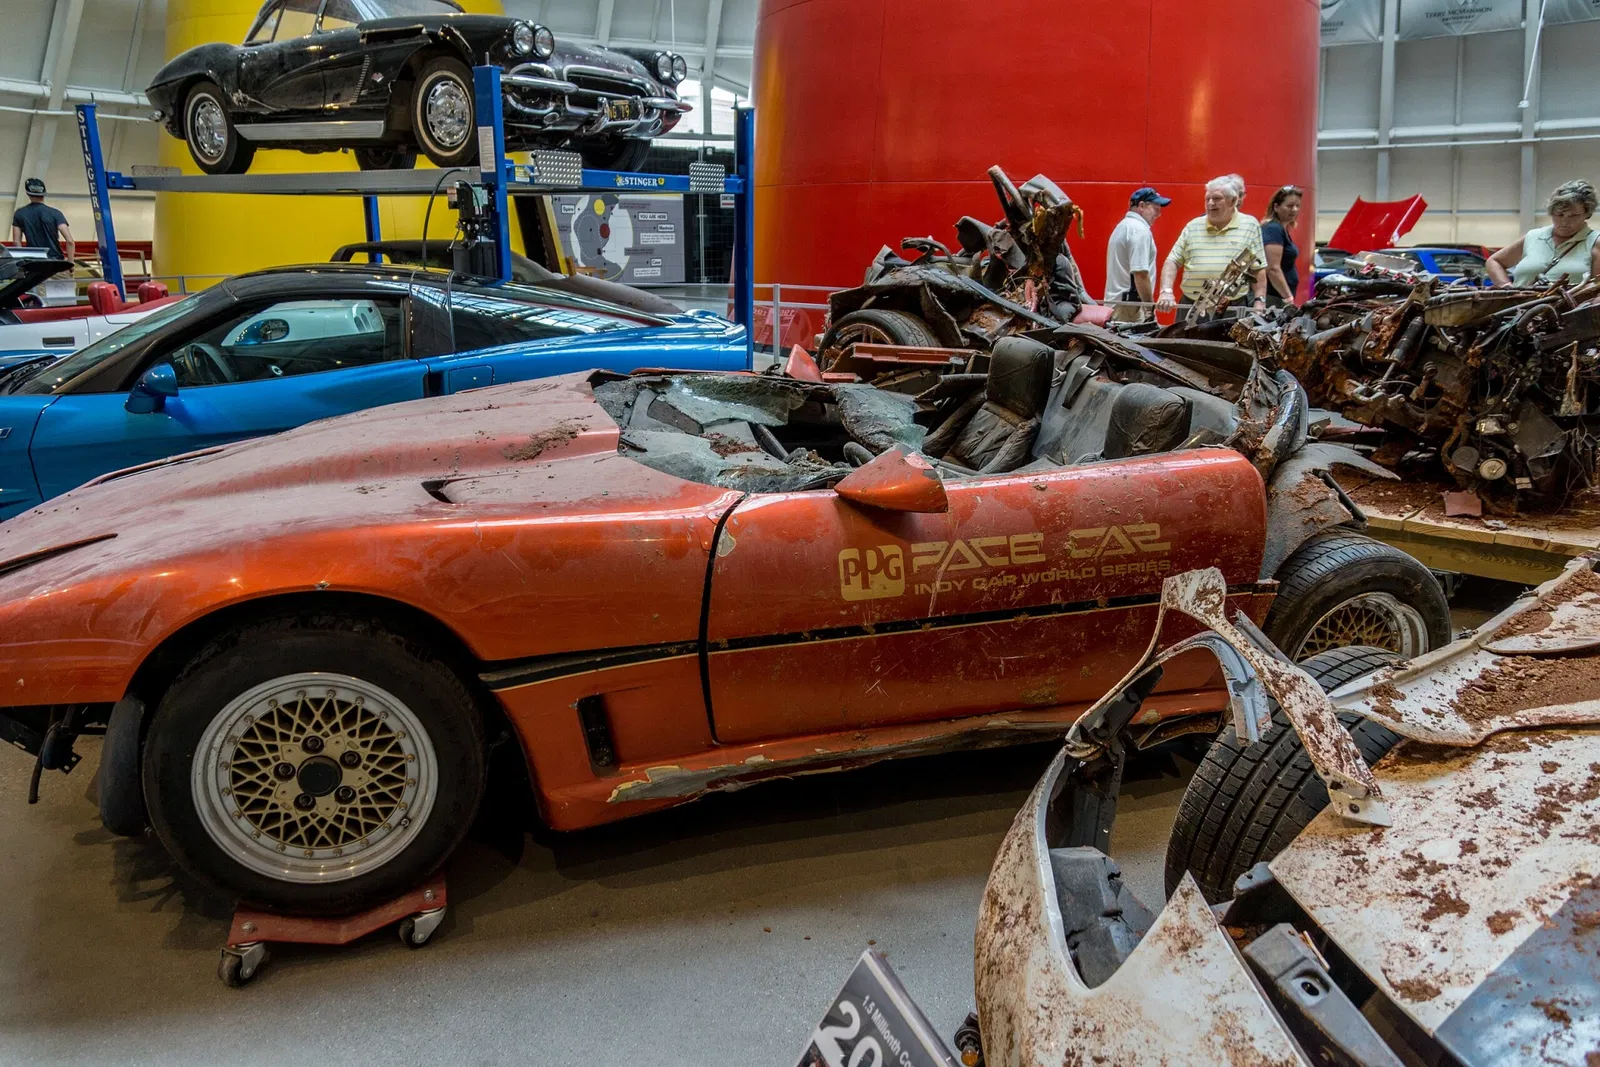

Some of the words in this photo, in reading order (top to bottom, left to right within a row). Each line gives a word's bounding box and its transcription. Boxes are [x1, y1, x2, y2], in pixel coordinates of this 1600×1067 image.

[77, 110, 100, 208] STINGER
[624, 176, 658, 187] STINGER
[840, 546, 904, 594] PPG
[911, 535, 1046, 573] PACE
[1066, 523, 1171, 559] CAR
[914, 579, 967, 595] INDY
[972, 574, 1018, 591] CAR
[1022, 567, 1097, 585] WORLD
[1101, 560, 1172, 577] SERIES
[862, 995, 876, 1014] 1.5
[870, 1008, 901, 1056] Millionth
